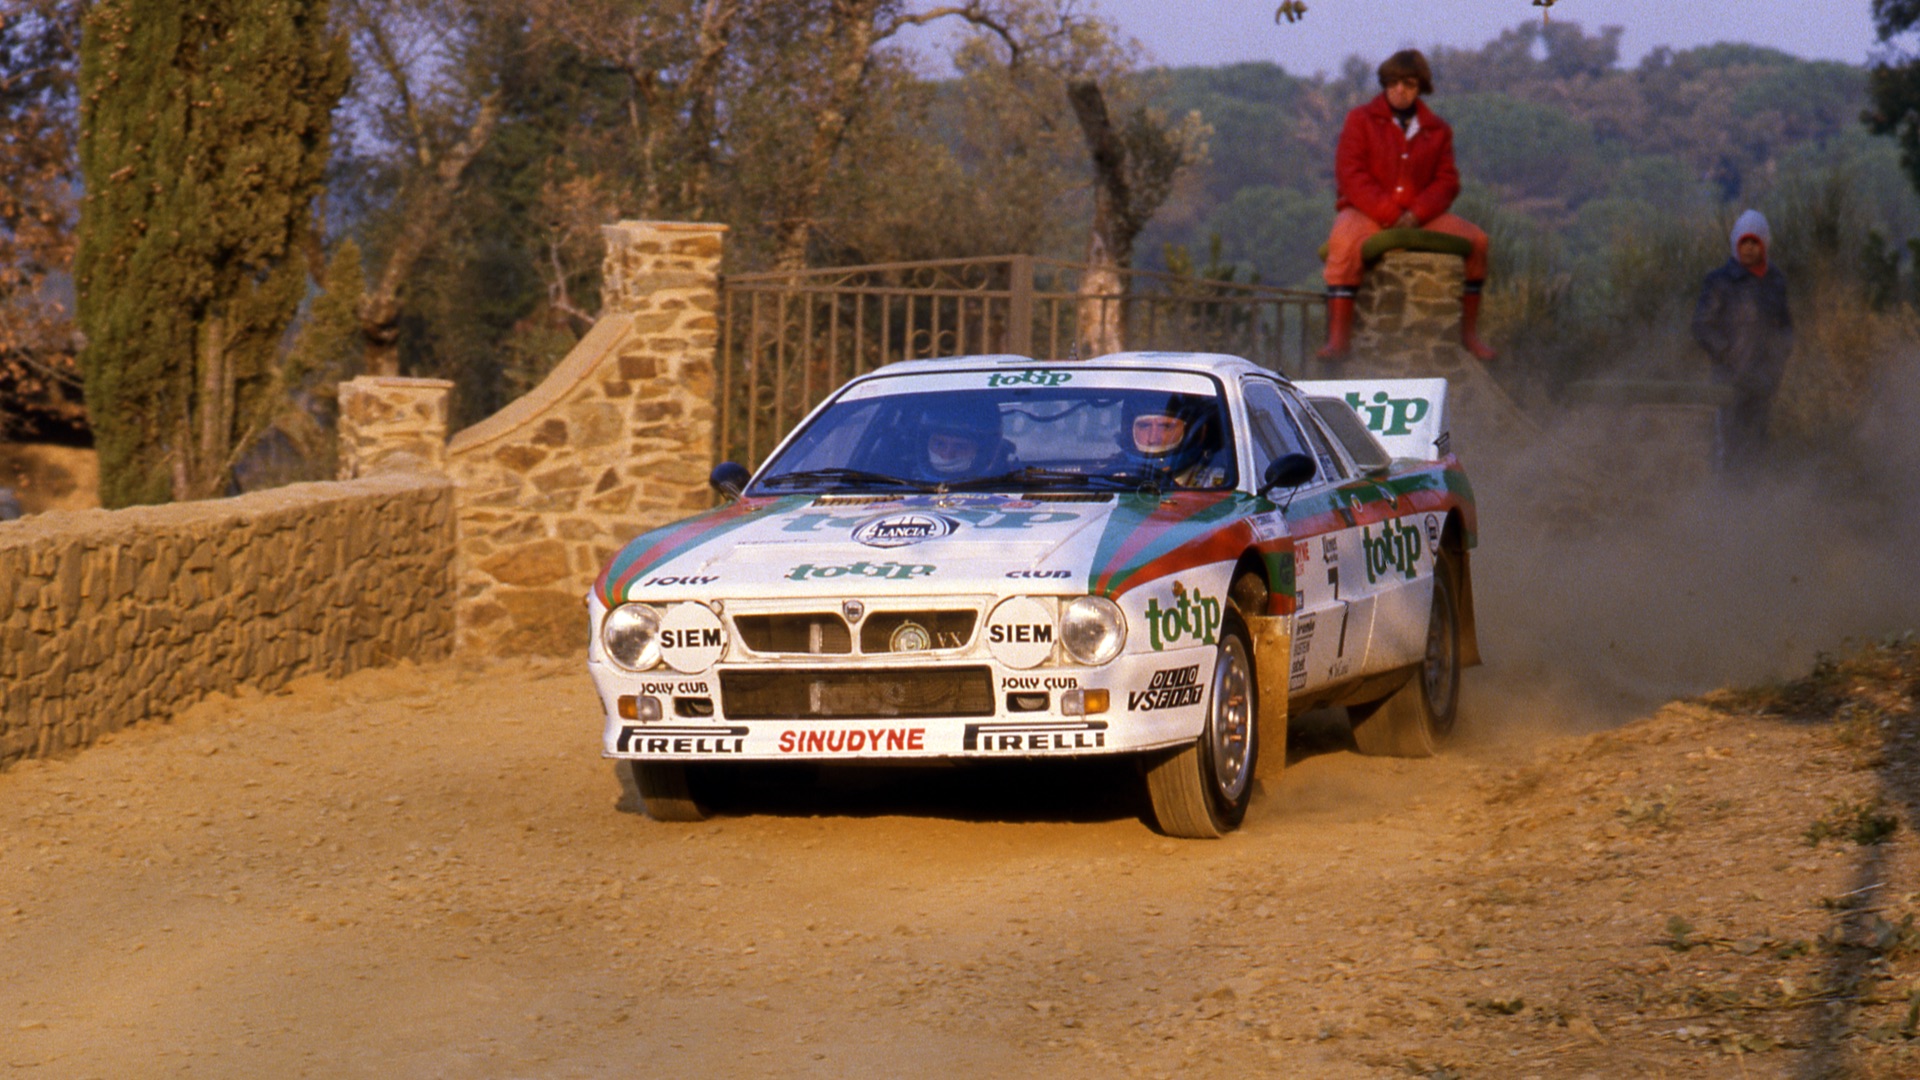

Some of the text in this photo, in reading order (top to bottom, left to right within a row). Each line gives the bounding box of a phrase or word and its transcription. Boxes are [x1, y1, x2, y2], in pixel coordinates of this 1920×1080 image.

[987, 370, 1073, 388] totip
[1345, 391, 1429, 436] tip
[877, 526, 928, 538] LANCIA
[1362, 517, 1422, 585] totip
[785, 561, 937, 581] totip
[1005, 570, 1073, 579] CLUB
[644, 576, 719, 587] JOLLY
[1144, 587, 1221, 652] totip
[660, 628, 722, 649] SIEM
[989, 624, 1053, 644] SIEM
[1001, 677, 1079, 690] JOLLY CLUB
[1149, 664, 1200, 690] OLIO
[641, 682, 710, 695] JOLLY CLUB
[616, 726, 751, 753] PIRELLI
[777, 728, 926, 753] SINUDYNE
[962, 721, 1109, 751] PIRELLI
